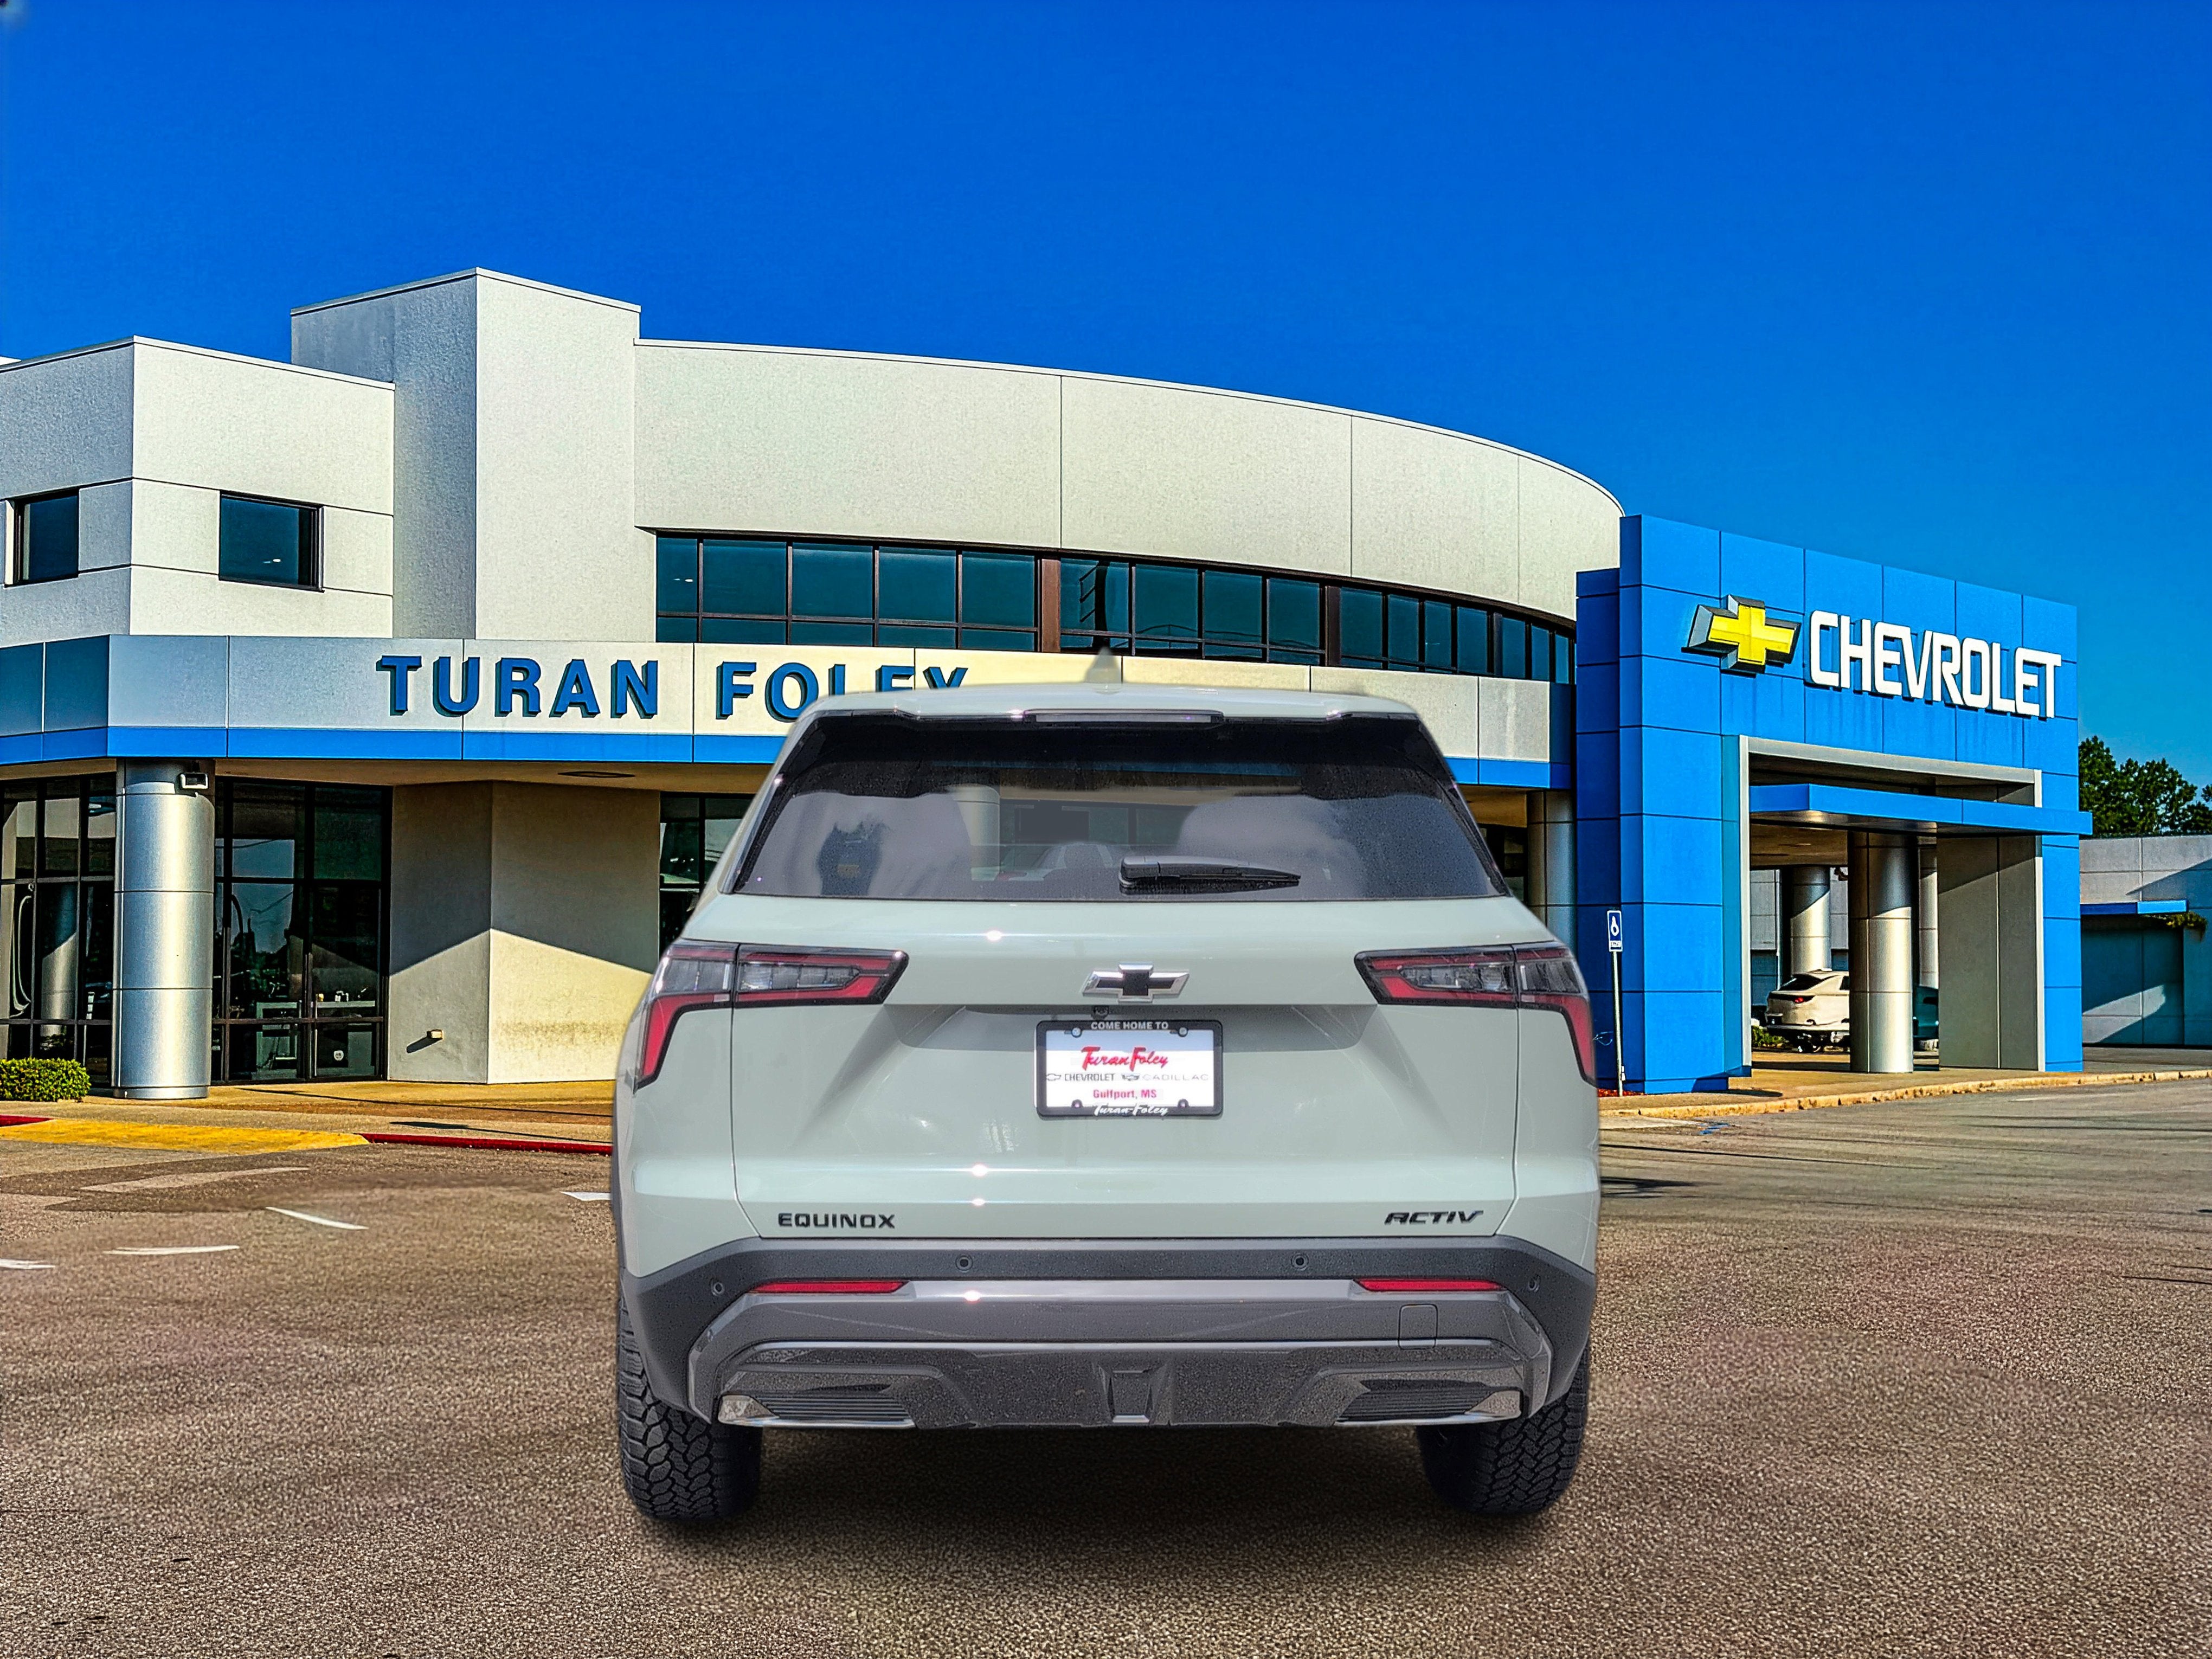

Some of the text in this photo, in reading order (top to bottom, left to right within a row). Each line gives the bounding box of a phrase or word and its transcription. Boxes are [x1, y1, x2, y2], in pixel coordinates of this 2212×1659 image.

[1809, 610, 2062, 718] CHEVROLET
[376, 655, 659, 719] TURAN
[1091, 1021, 1169, 1030] COME HOME TO
[1129, 1046, 1168, 1072] Foley
[1064, 1073, 1115, 1082] CHEVROLET
[1093, 1089, 1157, 1100] Gulfport, MS
[778, 1213, 895, 1229] EQUINOX
[1384, 1210, 1484, 1225] ACTIV
